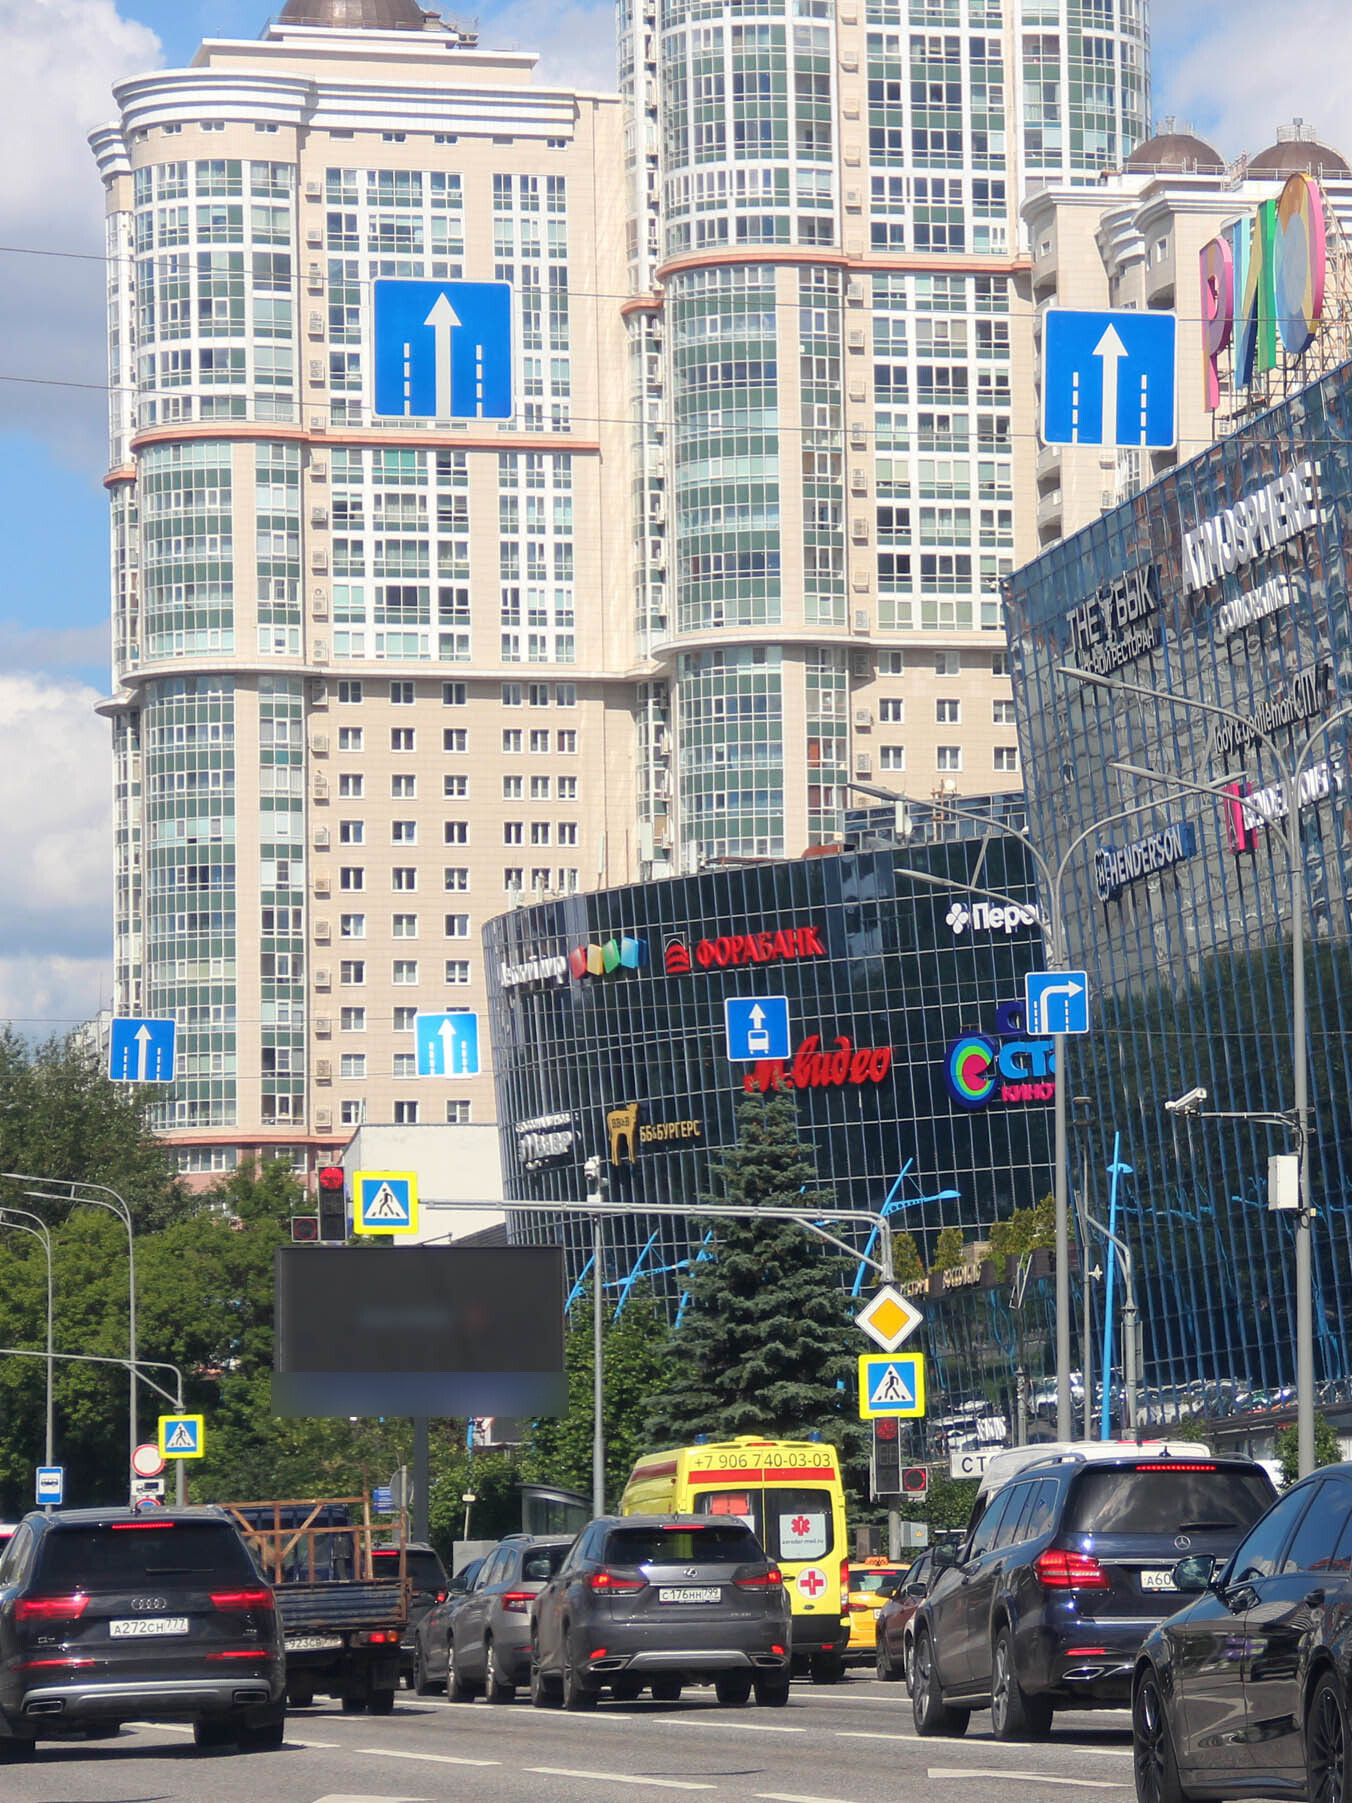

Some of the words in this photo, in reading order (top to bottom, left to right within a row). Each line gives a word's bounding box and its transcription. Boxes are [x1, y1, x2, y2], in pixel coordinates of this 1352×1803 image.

[1200, 172, 1326, 412] РИО
[1182, 462, 1318, 596] ATMOSPHERE
[1066, 598, 1100, 652] THE
[1293, 664, 1320, 719] CITY
[1109, 824, 1183, 886] HENDERSON
[972, 902, 1040, 934] Пере
[696, 1455, 713, 1469] +7
[720, 1454, 748, 1468] 906
[752, 1453, 831, 1468] 740-03-03
[662, 1590, 701, 1600] С176НН
[1147, 1573, 1171, 1585] А60
[114, 1621, 163, 1634] А272СН
[166, 1618, 185, 1630] 777
